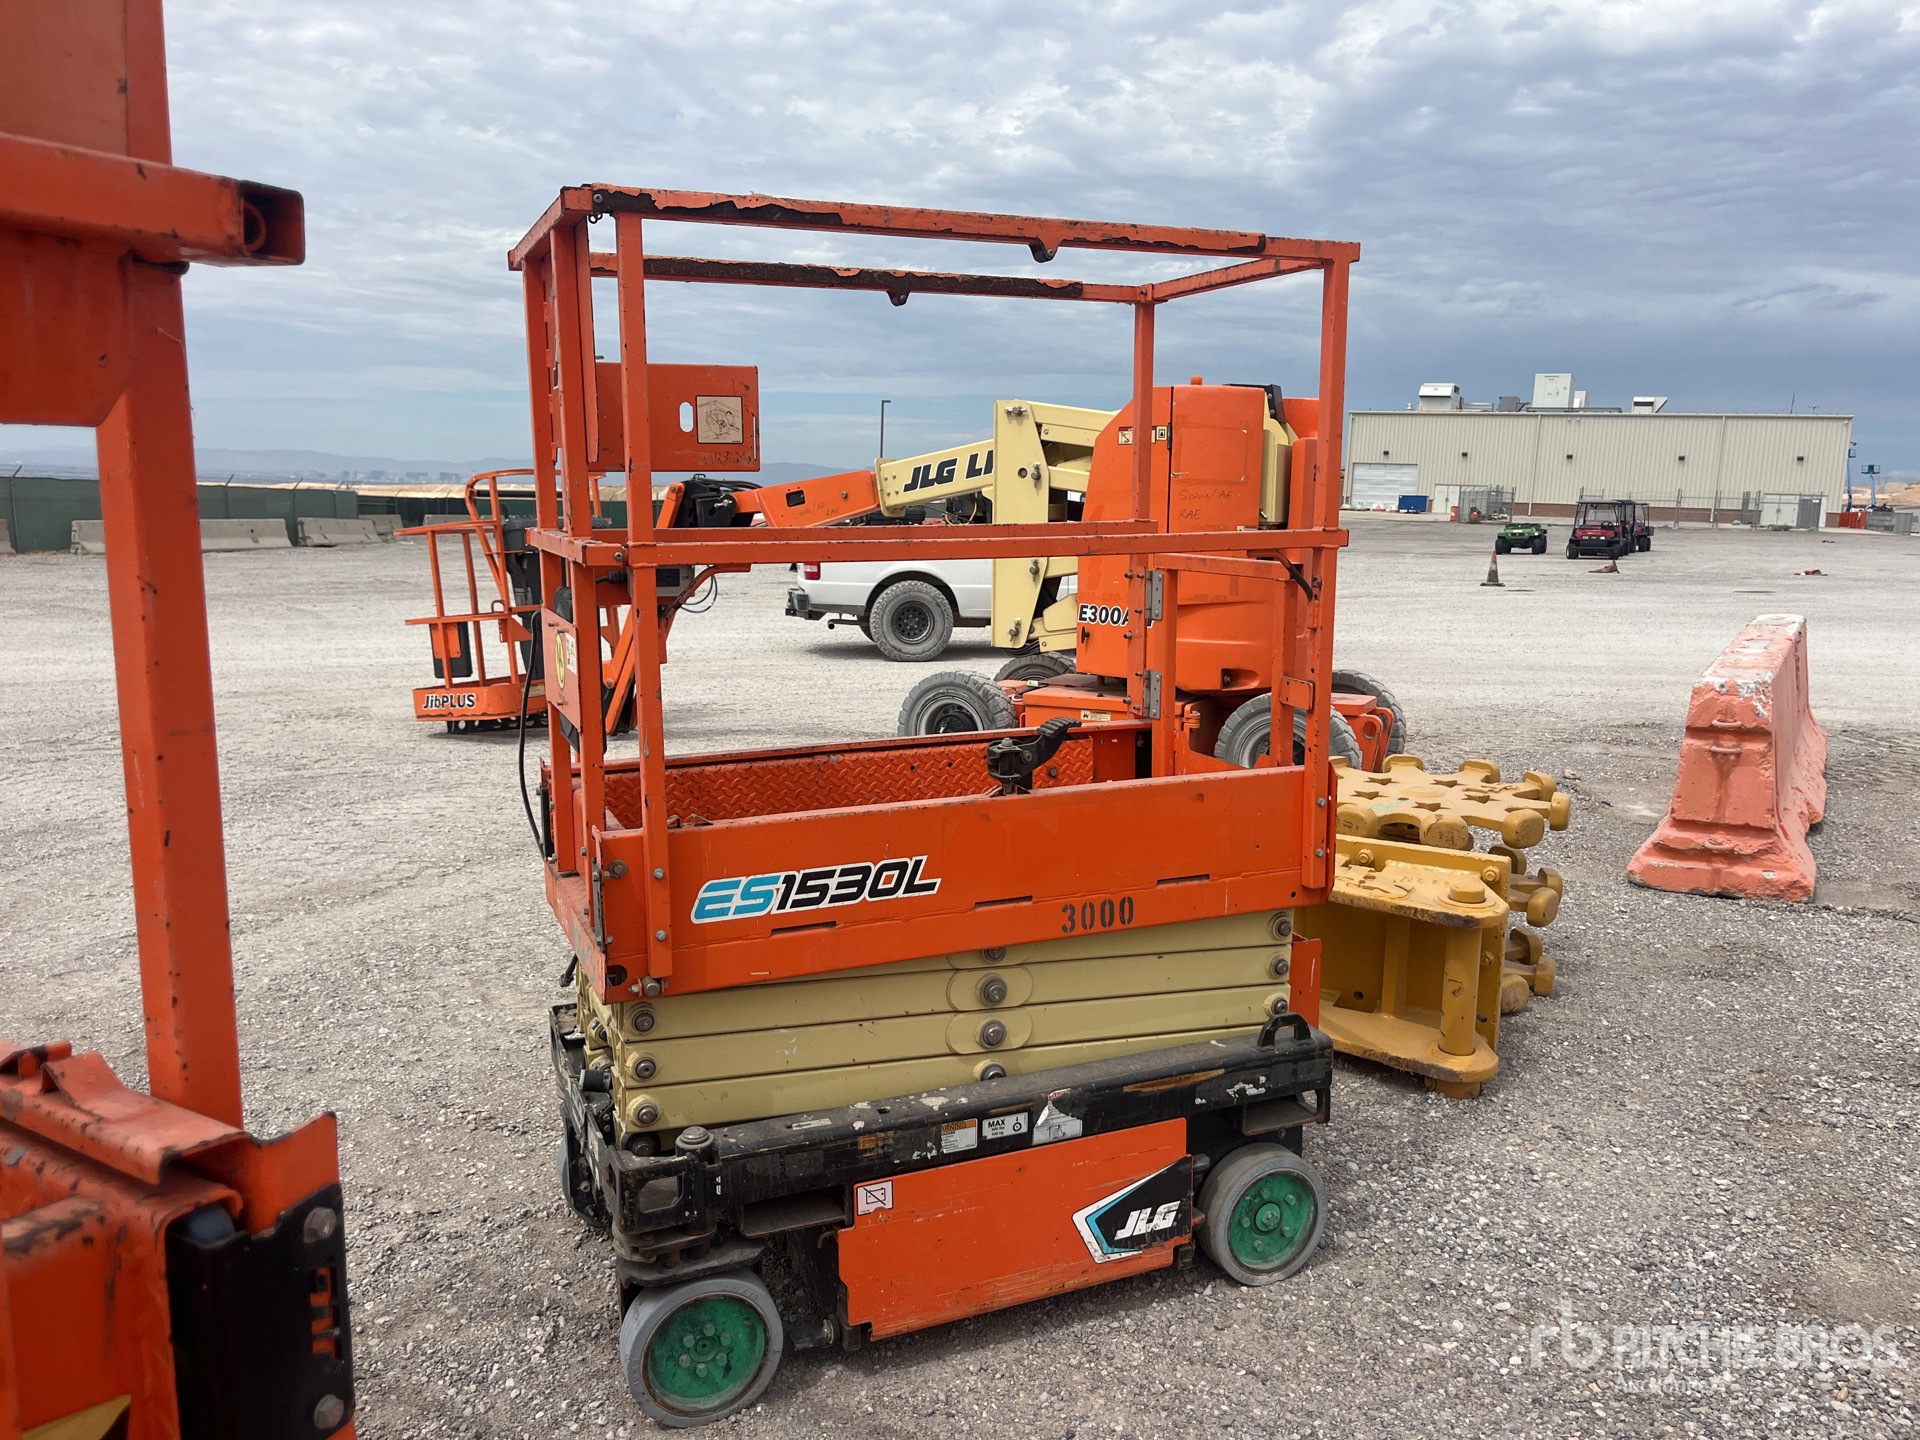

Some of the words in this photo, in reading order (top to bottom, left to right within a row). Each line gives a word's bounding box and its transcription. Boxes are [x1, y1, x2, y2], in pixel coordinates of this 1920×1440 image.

[902, 457, 958, 493] JLG
[964, 449, 994, 479] LI
[1078, 603, 1153, 629] E300A
[423, 693, 476, 710] JibPLUS
[692, 856, 941, 923] ES1530L
[1061, 896, 1134, 934] 3000
[988, 1119, 1006, 1128] MAX
[1114, 1200, 1180, 1240] JLG
